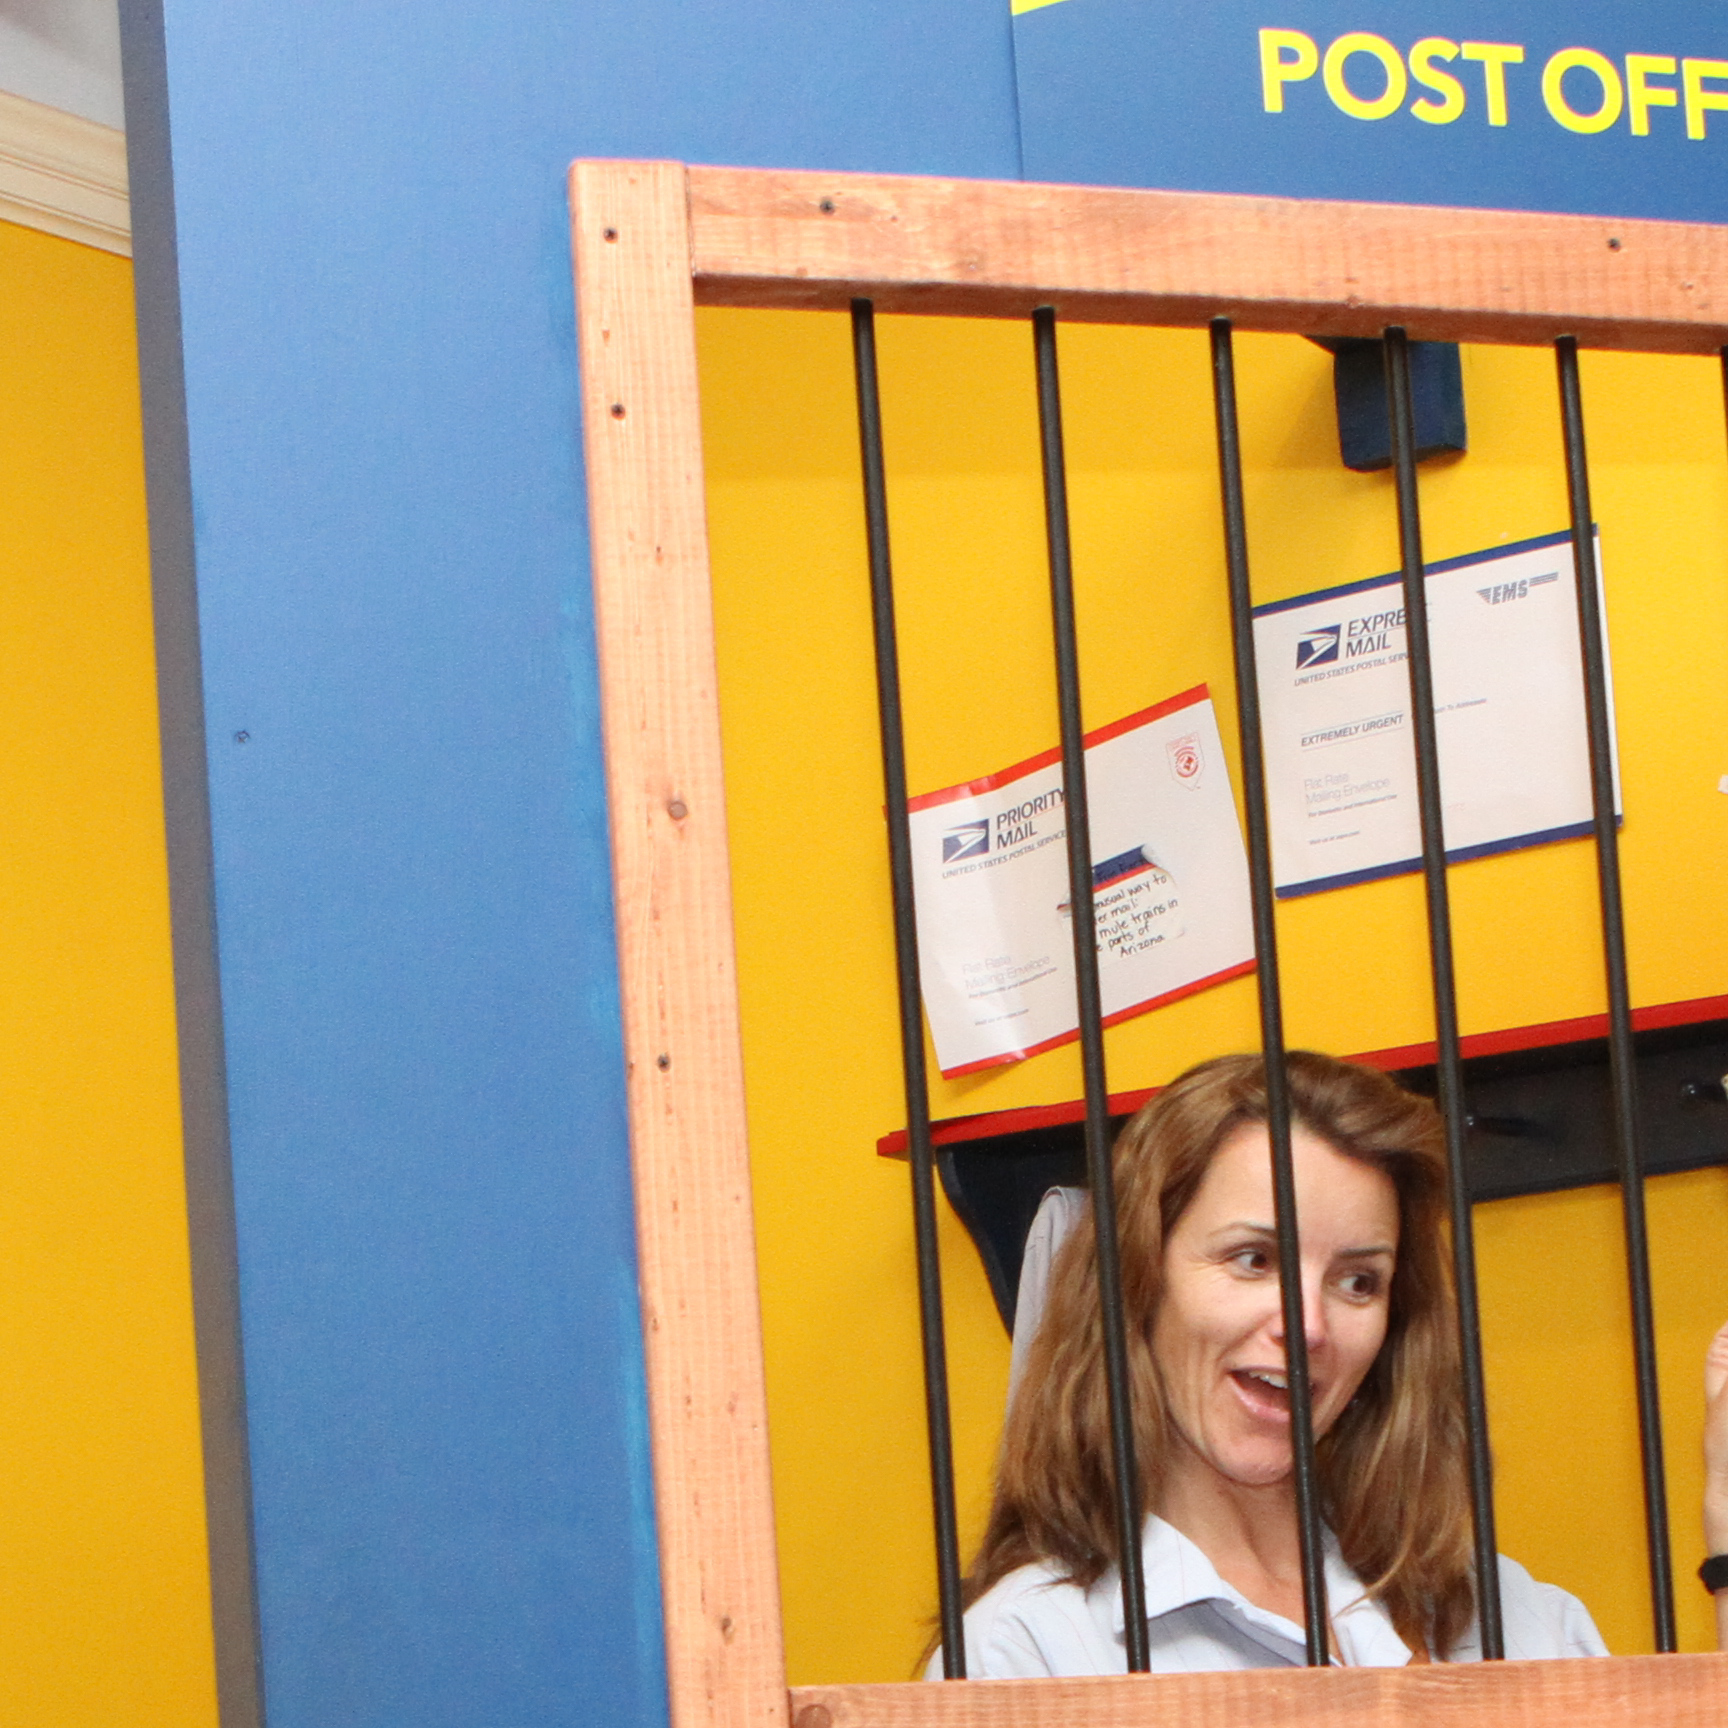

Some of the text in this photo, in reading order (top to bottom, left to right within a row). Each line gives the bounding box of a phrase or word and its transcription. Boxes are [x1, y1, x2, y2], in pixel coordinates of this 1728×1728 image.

[1258, 27, 1525, 127] POST
[1492, 579, 1528, 605] EMS
[1348, 605, 1424, 637] EXPRE
[1346, 633, 1392, 658] MAIL
[1294, 652, 1409, 687] UNITED STATES POSTAL SERV
[1301, 713, 1404, 747] EXTREMELY URGENT
[997, 788, 1068, 830] PRIORITY
[997, 821, 1038, 849] MAIL
[942, 864, 977, 879] UNITED
[978, 854, 1008, 870] STATES
[1009, 844, 1036, 861] POSTAL
[1127, 880, 1151, 897] way
[1153, 874, 1167, 885] to
[1099, 898, 1179, 939] mule trains in
[1108, 930, 1134, 952] parts
[1138, 920, 1150, 936] of
[1120, 934, 1165, 958] Arizona
